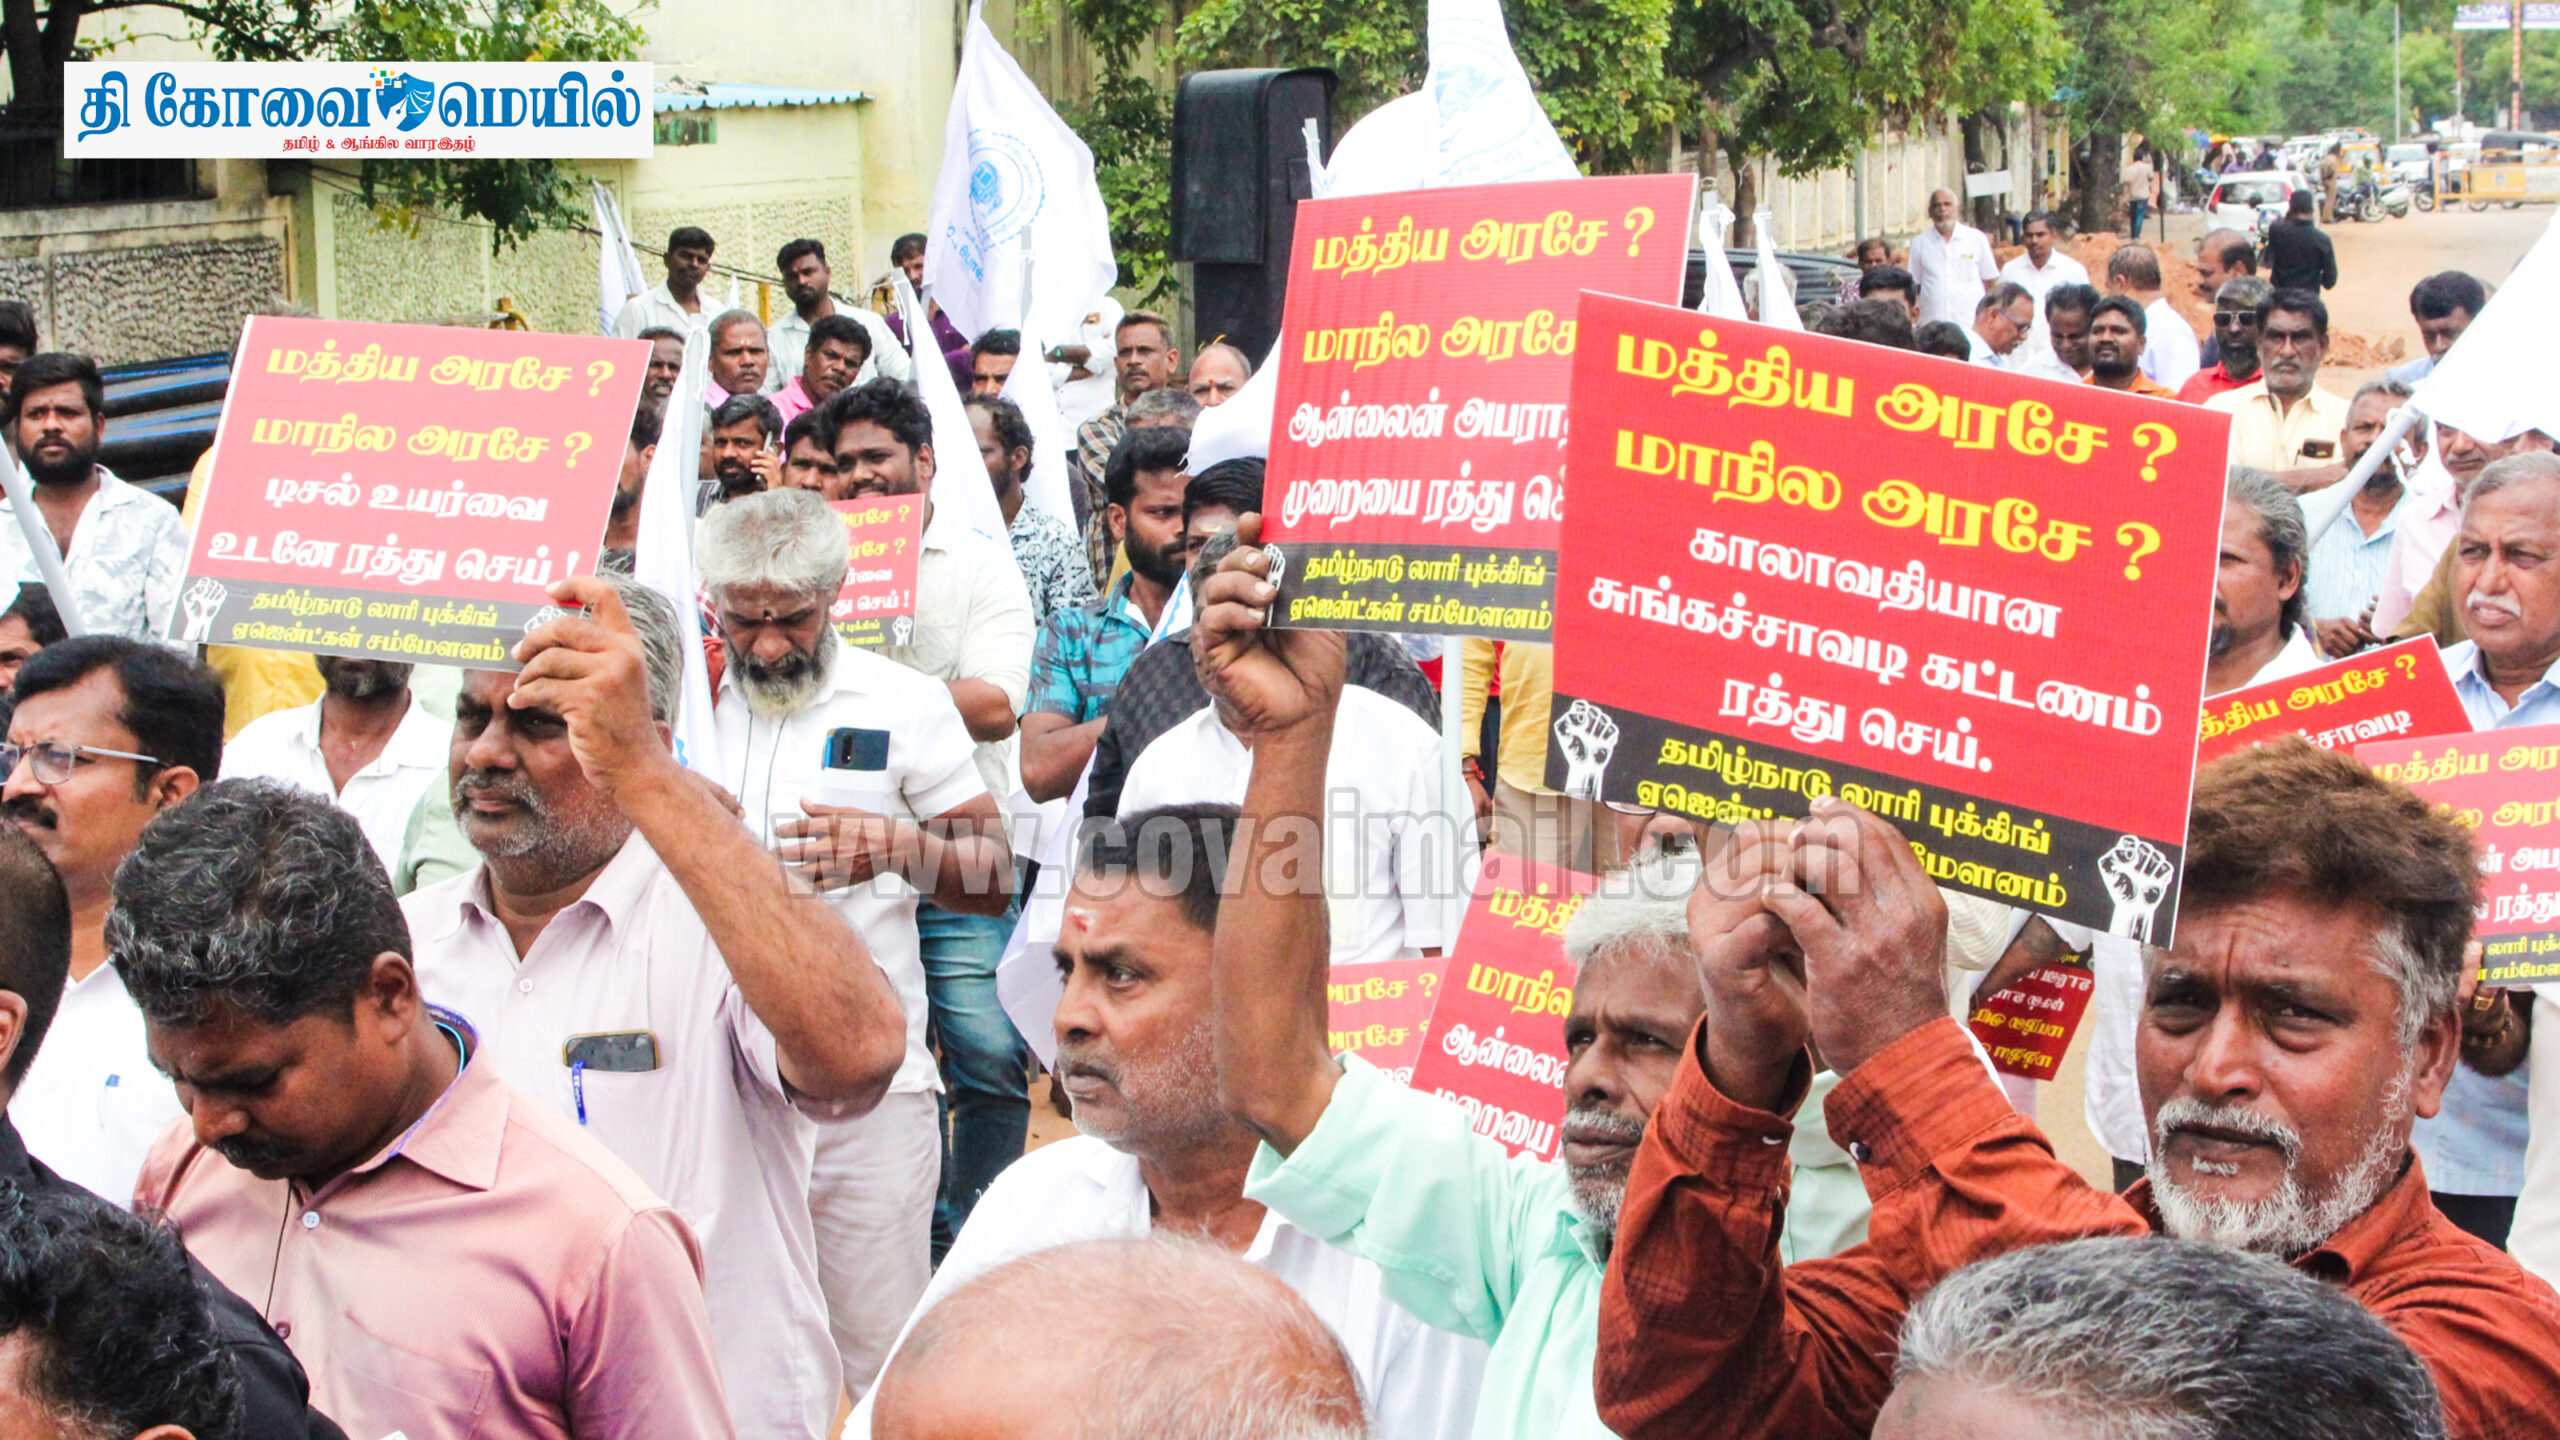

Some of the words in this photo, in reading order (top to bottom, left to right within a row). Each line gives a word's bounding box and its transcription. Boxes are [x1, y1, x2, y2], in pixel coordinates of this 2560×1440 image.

[1312, 215, 1449, 279] மத்திய
[1459, 210, 1609, 264] அரசே
[1624, 207, 1655, 258] ?
[1302, 311, 1430, 373] மாநில
[266, 339, 419, 385] மத்திய
[429, 354, 572, 393] அரசே
[586, 360, 615, 396] ?
[1288, 387, 1448, 448] ஆன்லைன்
[1453, 397, 1568, 451] அபரா
[1616, 329, 1856, 419] மத்திய
[1874, 382, 2109, 465] அரசே
[2132, 422, 2178, 482] ?
[252, 413, 397, 456] மாநில
[407, 425, 550, 463] அரசே
[564, 431, 593, 468] ?
[265, 472, 361, 507] டிசல்
[368, 480, 549, 522] உயர்வை
[898, 504, 911, 523] ?
[1282, 474, 1421, 528] முறையை
[1422, 460, 1515, 533] ரத்து
[1615, 428, 1843, 512] மாநில
[1860, 478, 2093, 563] அரசே
[2116, 522, 2162, 581] ?
[207, 530, 341, 568] உடனே
[342, 533, 445, 587] ரத்து
[455, 545, 552, 586] செய்
[848, 540, 889, 560] ரசே
[893, 537, 907, 556] ?
[1303, 550, 1404, 584] தமிழ்நாடு
[1407, 555, 1460, 582] லாரி
[1463, 556, 1546, 590] புக்கிங்
[844, 567, 893, 586] ர்வை
[857, 588, 899, 612] செய்
[1688, 526, 2063, 640] காலாவதியான
[250, 589, 363, 617] தமிழ்நாடு
[366, 599, 419, 622] லாரி
[420, 601, 498, 628] புக்கிங்
[1290, 591, 1406, 624] ஏஜென்ட்கள்
[1407, 597, 1553, 632] சம்மேளனம்
[232, 621, 363, 650] ஏஜென்ட்கள்
[366, 627, 505, 662] சம்மேளனம்
[1587, 575, 1908, 686] சுங்கச்சாவடி
[1920, 651, 2163, 738] கட்டணம்
[2200, 699, 2281, 742] த்திய
[2287, 669, 2389, 710] அரசே
[2394, 654, 2417, 680] ?
[1719, 673, 1846, 744] ரத்து
[1859, 706, 1994, 774] செய்.
[2373, 747, 2490, 785] மத்திய
[2498, 745, 2560, 772] அர
[1637, 779, 1797, 826] ஏஜென்
[1657, 738, 1832, 800] தமிழ்நாடு
[1841, 781, 1921, 822] லாரி
[1929, 802, 2051, 855] புக்கிங்
[2492, 796, 2560, 828] அர
[2510, 847, 2560, 872] அப
[1488, 883, 1583, 937] மத்தி
[2487, 935, 2529, 956] லாரி
[2531, 933, 2560, 955] புக்
[1418, 972, 1438, 998] ?
[2491, 961, 2560, 980] சம்மேள
